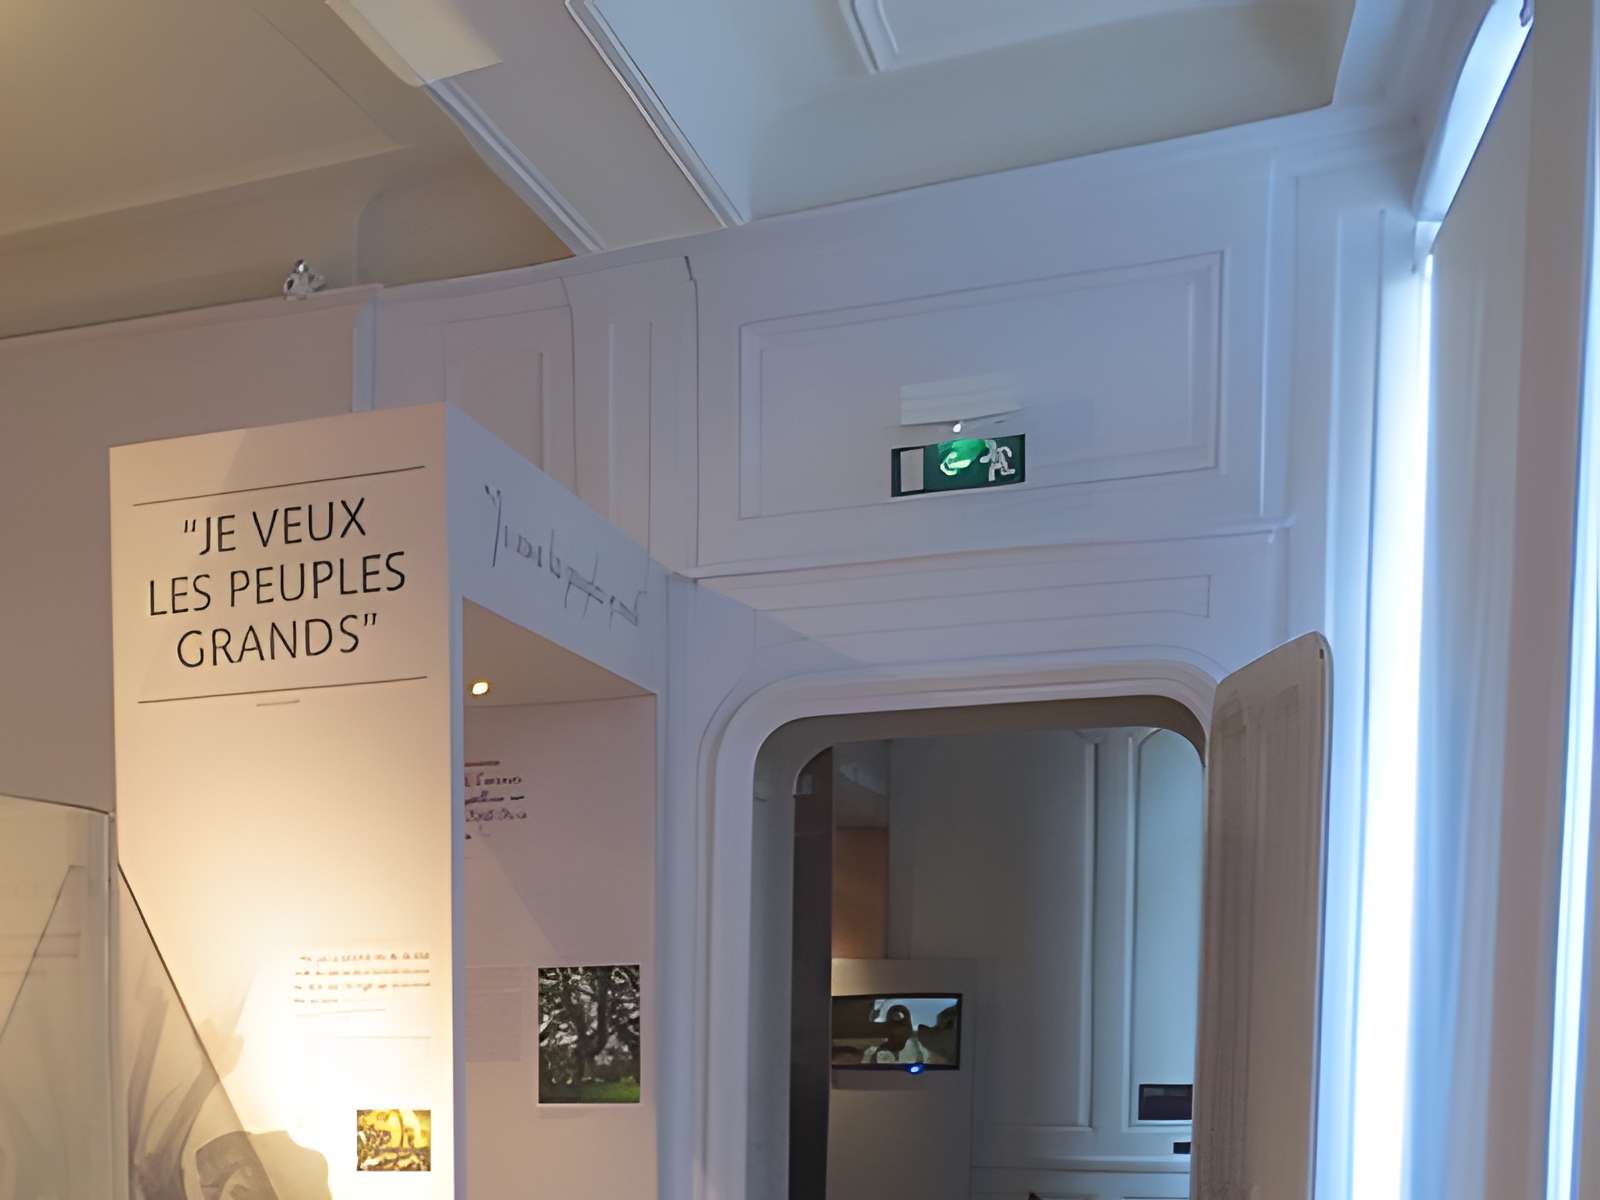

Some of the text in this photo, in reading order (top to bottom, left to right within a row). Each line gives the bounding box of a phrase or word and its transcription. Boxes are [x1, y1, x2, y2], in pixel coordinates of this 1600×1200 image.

[252, 497, 366, 548] VEUX
[149, 550, 406, 616] LES PEUPLES
